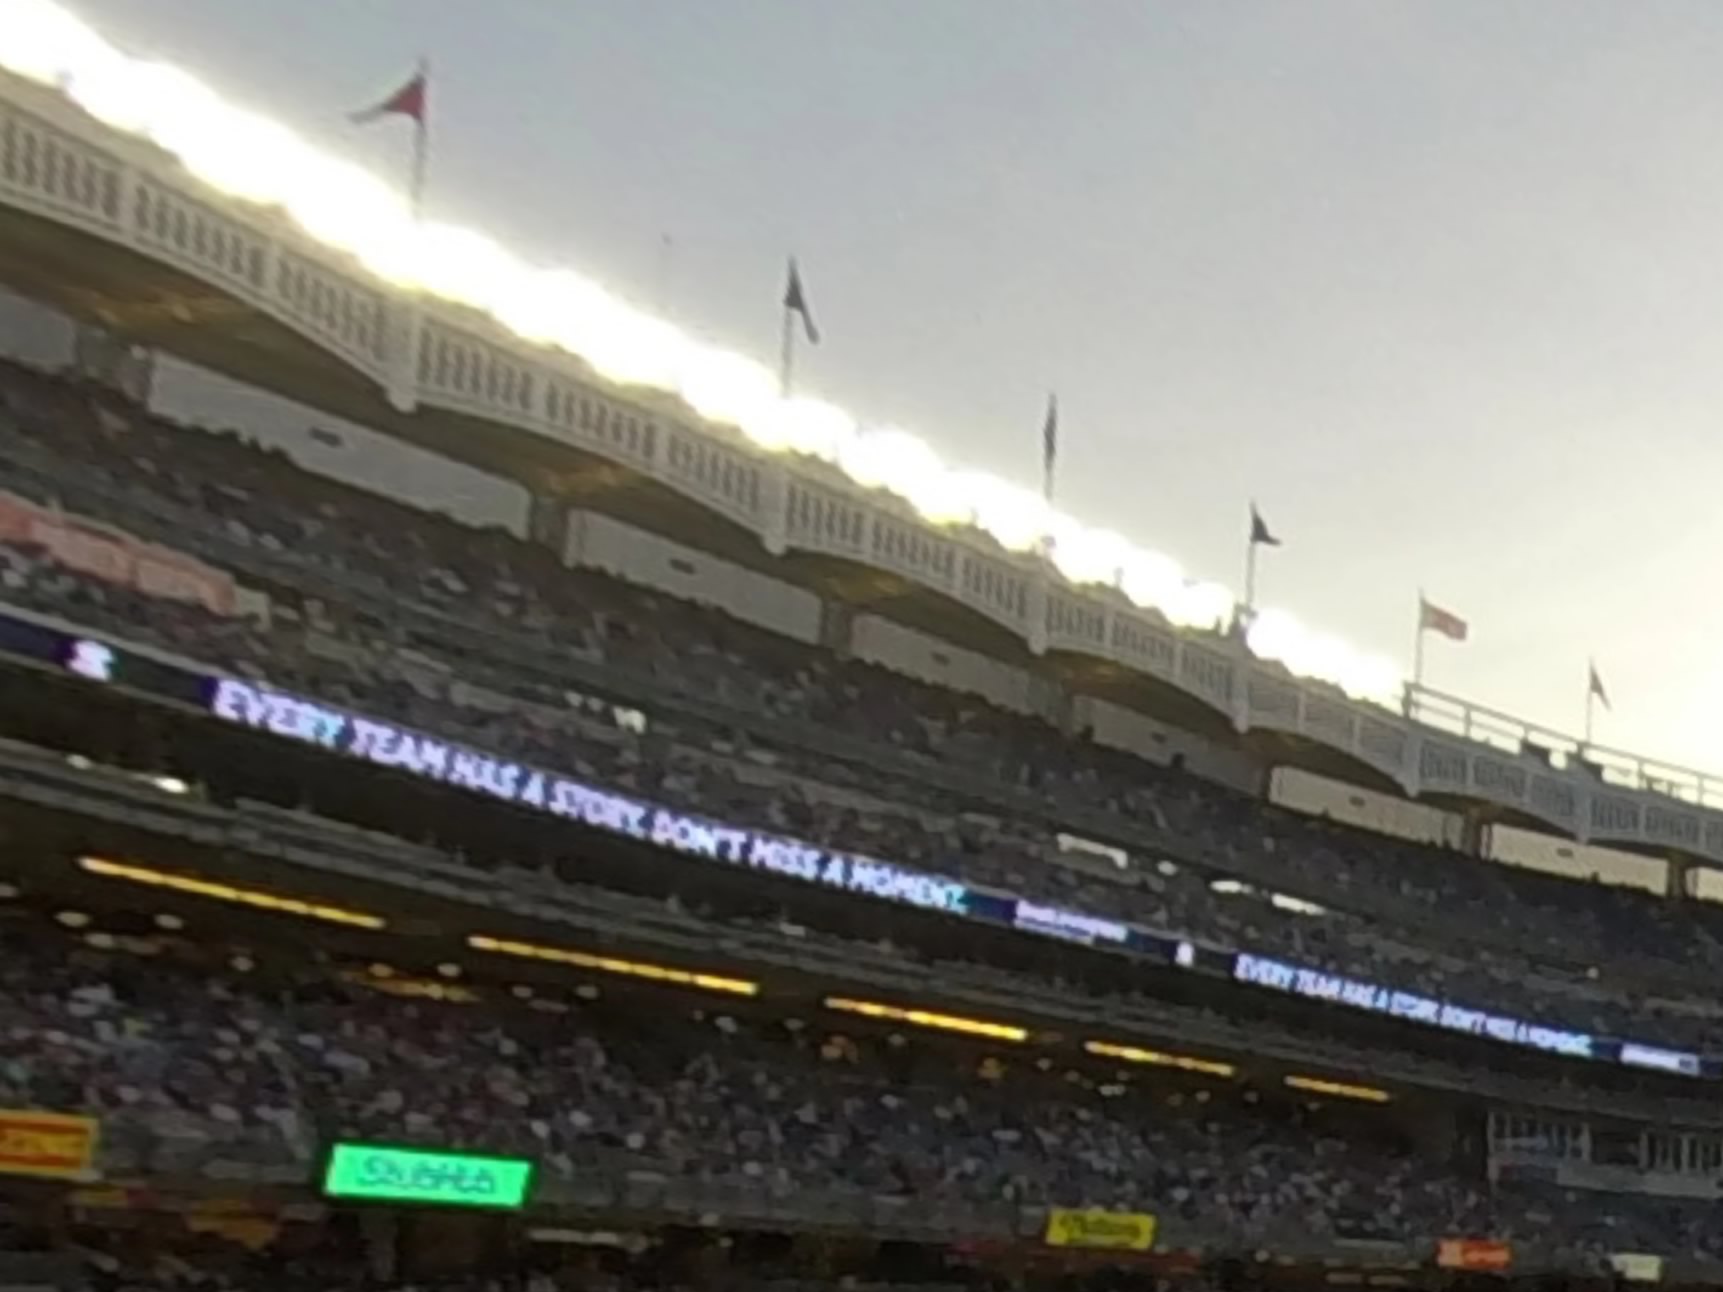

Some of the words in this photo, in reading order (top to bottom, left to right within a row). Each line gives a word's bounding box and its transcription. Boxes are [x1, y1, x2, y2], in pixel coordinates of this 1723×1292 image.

[213, 679, 344, 748] EVERY
[350, 718, 447, 778] TEAM
[450, 748, 520, 800] HAS
[520, 770, 546, 805] A
[651, 810, 747, 865] DON'T
[750, 833, 821, 881] MISS
[820, 856, 845, 888] A
[1233, 953, 1294, 989] EVERY
[1295, 969, 1341, 999] TEAM
[1343, 980, 1378, 1010] HAS
